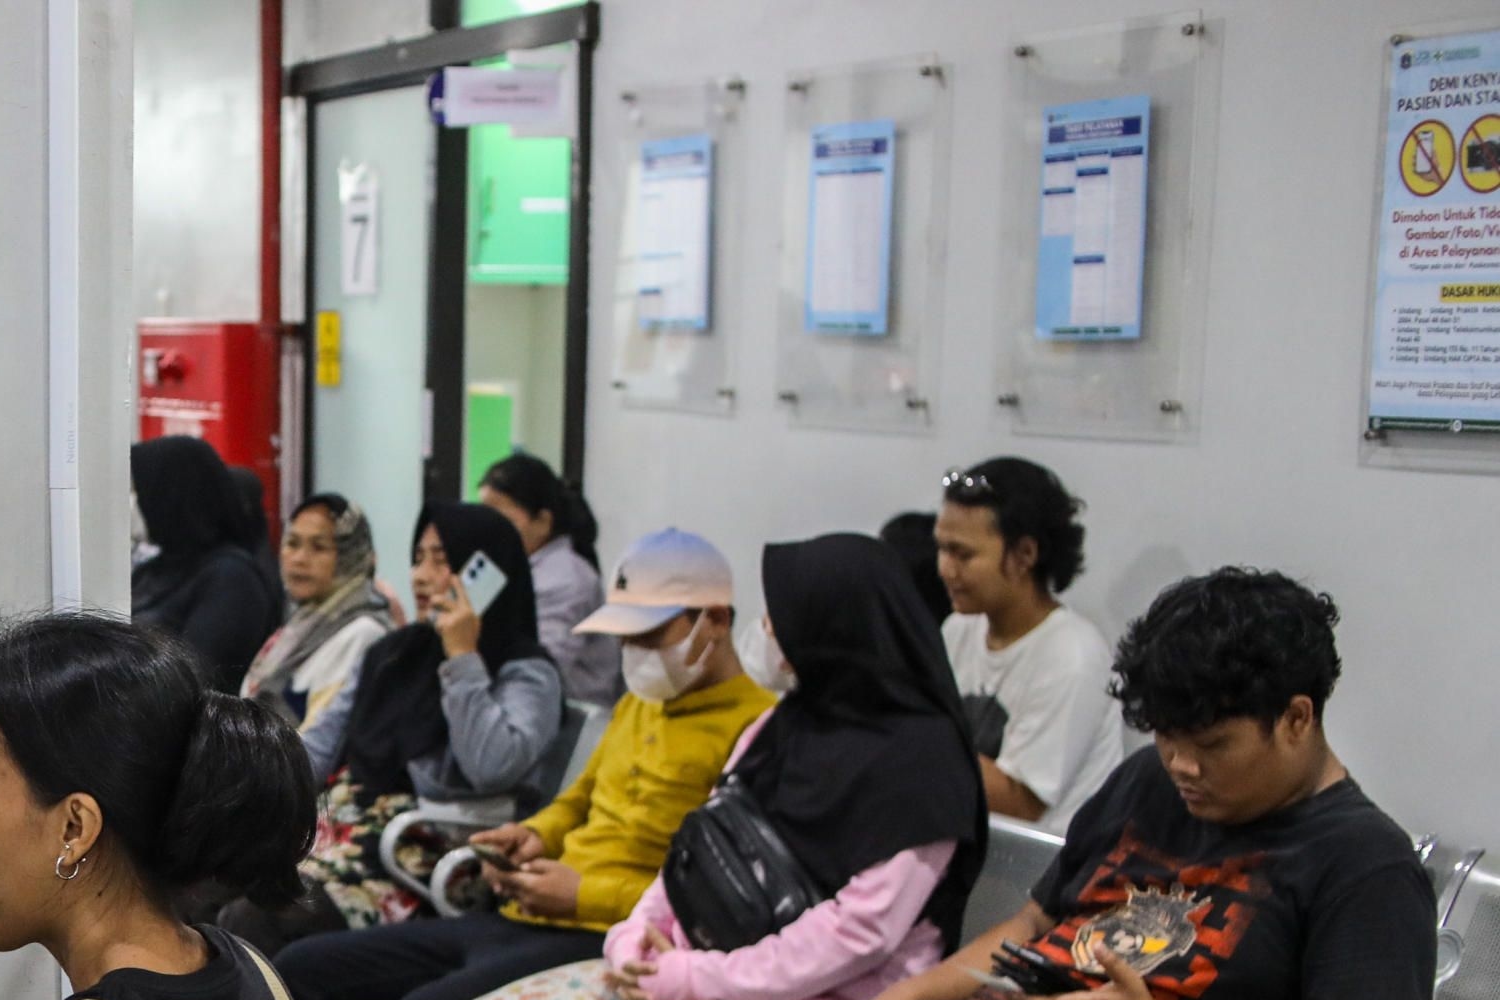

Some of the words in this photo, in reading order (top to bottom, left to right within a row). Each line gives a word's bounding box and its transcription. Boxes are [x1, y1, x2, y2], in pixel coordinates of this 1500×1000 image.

[1429, 75, 1460, 92] DEMI
[1397, 95, 1442, 112] PASIEN
[1444, 92, 1473, 109] DAN
[1392, 210, 1440, 224] Dimohon
[1443, 207, 1476, 221] Untuk
[1399, 245, 1409, 259] di
[1411, 245, 1438, 259] Area
[1441, 286, 1474, 298] DASAR
